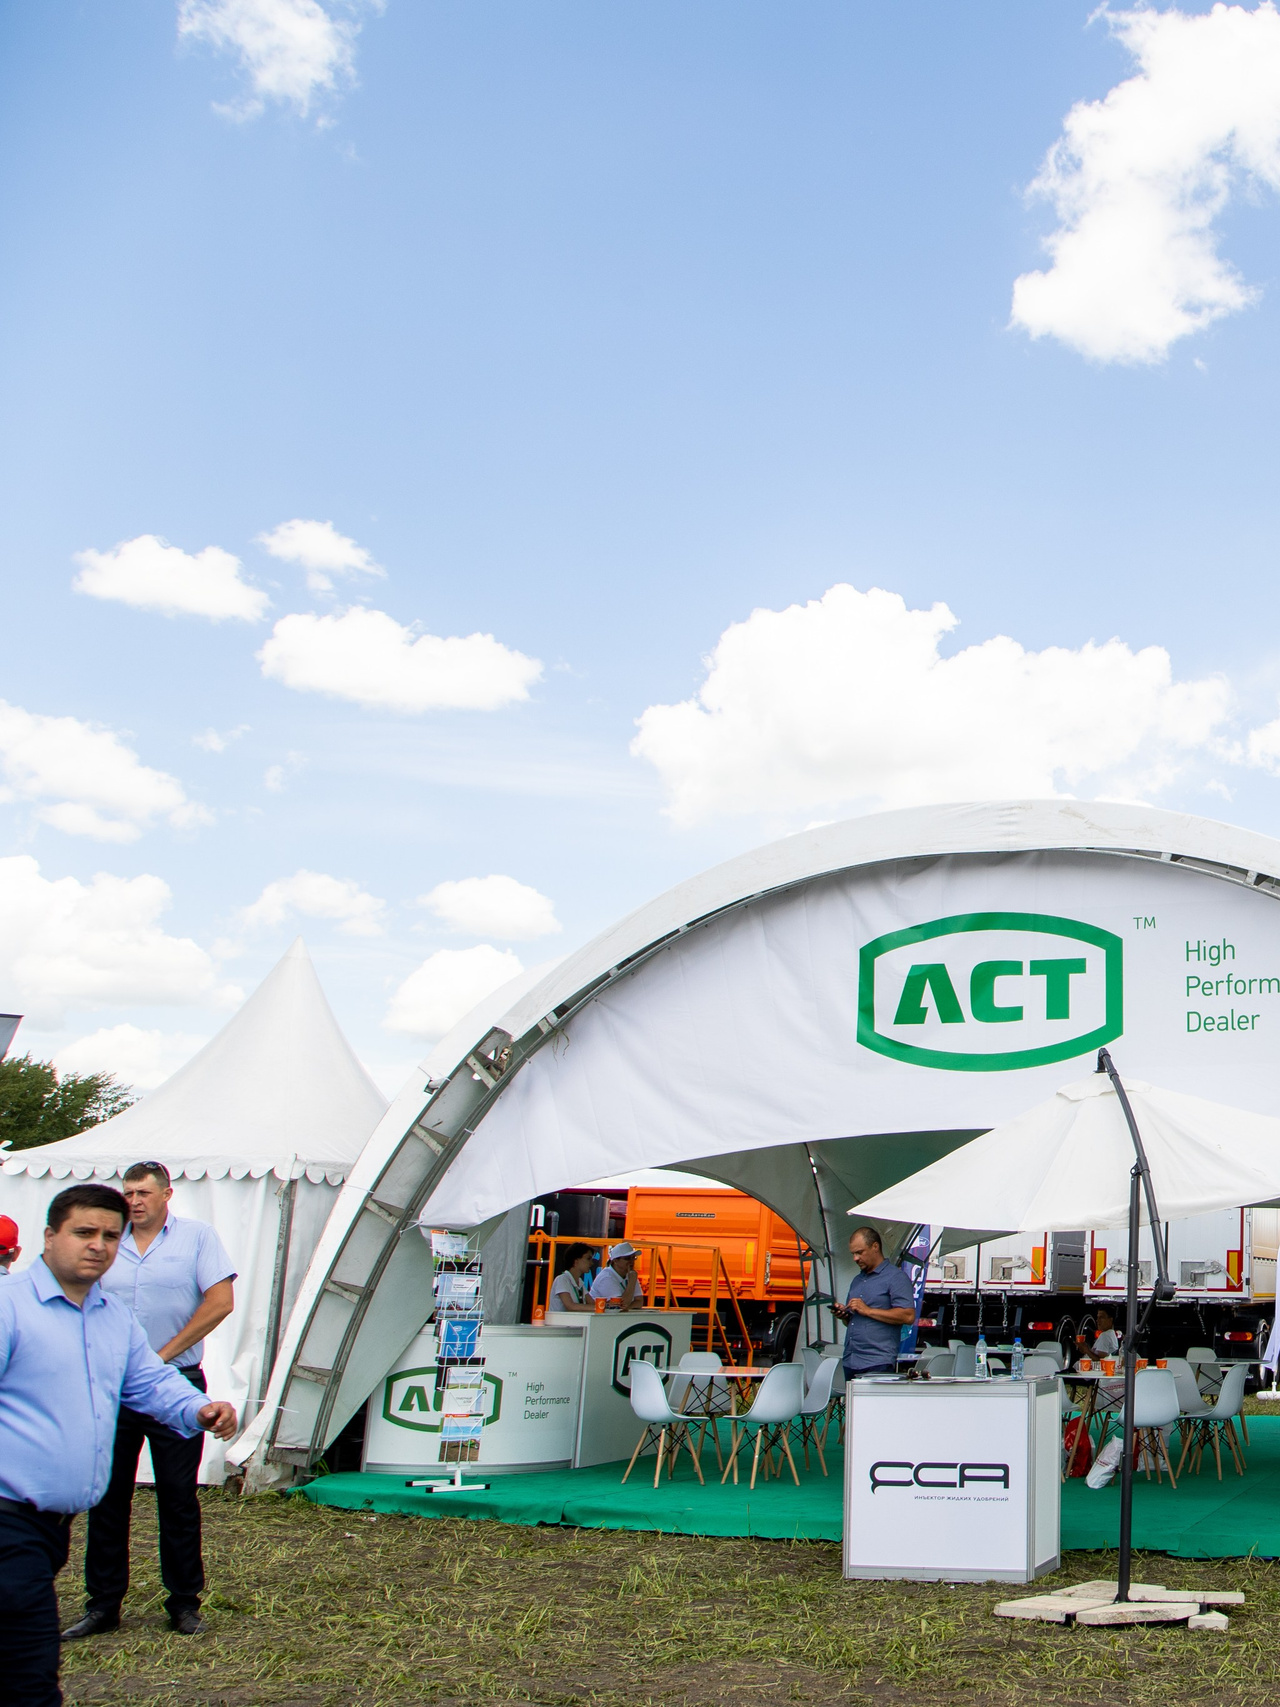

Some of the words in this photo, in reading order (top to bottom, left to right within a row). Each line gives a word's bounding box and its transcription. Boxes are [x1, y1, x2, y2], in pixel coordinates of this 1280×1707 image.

[1185, 938, 1236, 967] High
[893, 957, 1087, 1025] ACT
[1186, 1010, 1261, 1033] Dealer
[526, 1382, 545, 1395] High
[525, 1395, 571, 1406] Performance
[524, 1409, 550, 1421] Dealer
